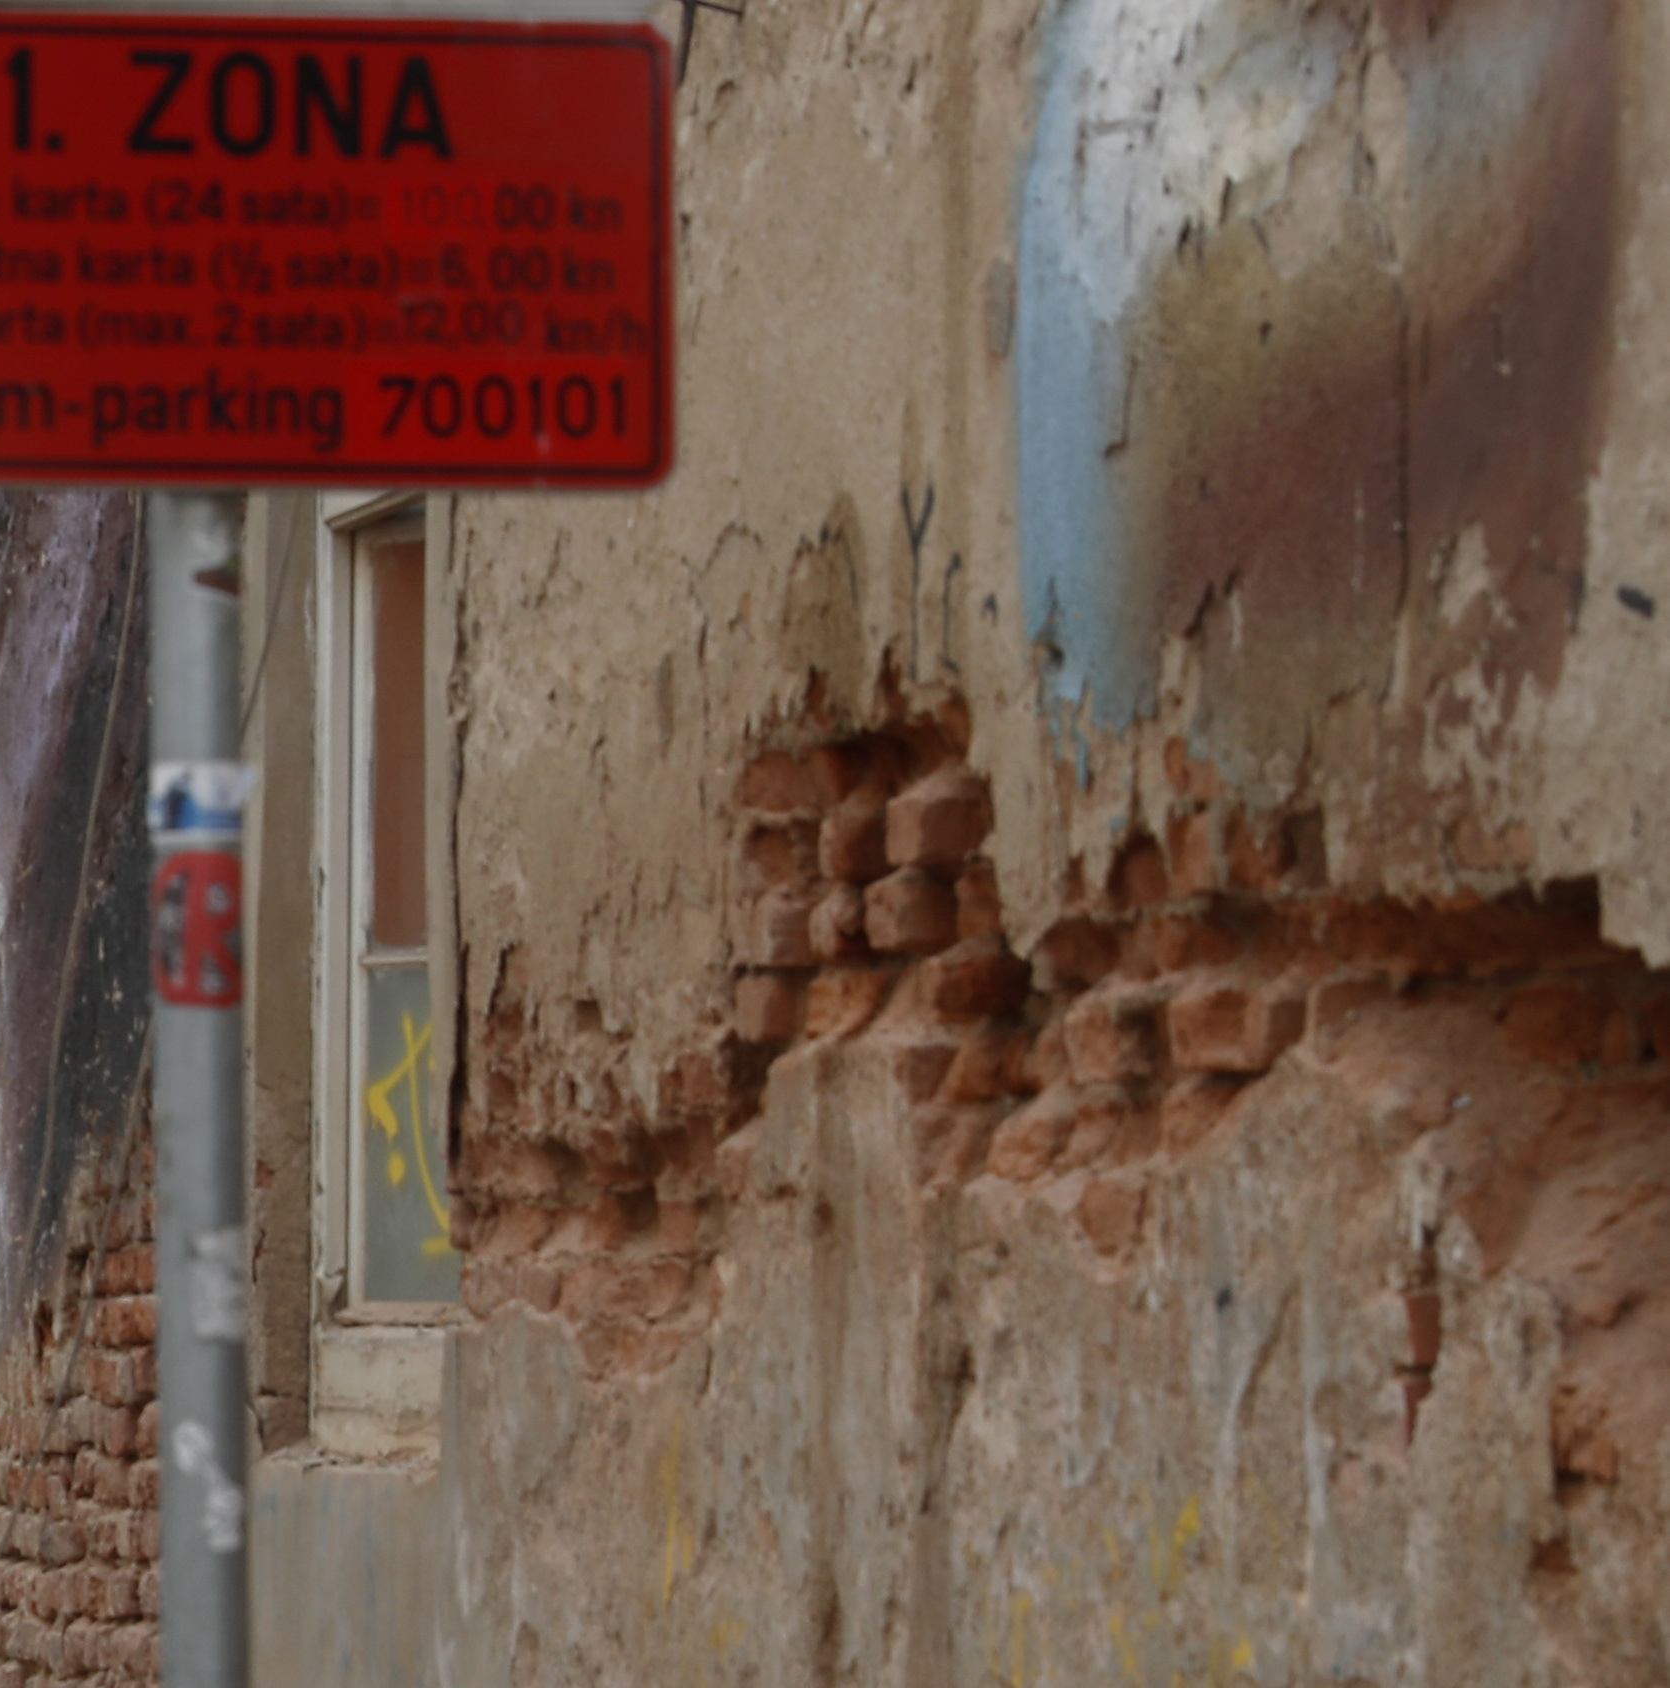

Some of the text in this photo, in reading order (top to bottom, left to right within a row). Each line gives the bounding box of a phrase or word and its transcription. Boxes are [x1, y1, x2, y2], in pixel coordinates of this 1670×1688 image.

[5, 46, 455, 160] 1. ZONA
[12, 174, 130, 223] karta
[146, 176, 226, 230] (24
[567, 182, 626, 232] kn
[77, 236, 197, 287] karta
[561, 246, 617, 294] kn
[76, 300, 208, 353] (max.
[212, 302, 243, 348] 2
[543, 305, 649, 356] kn/h
[379, 373, 626, 440] 700101
